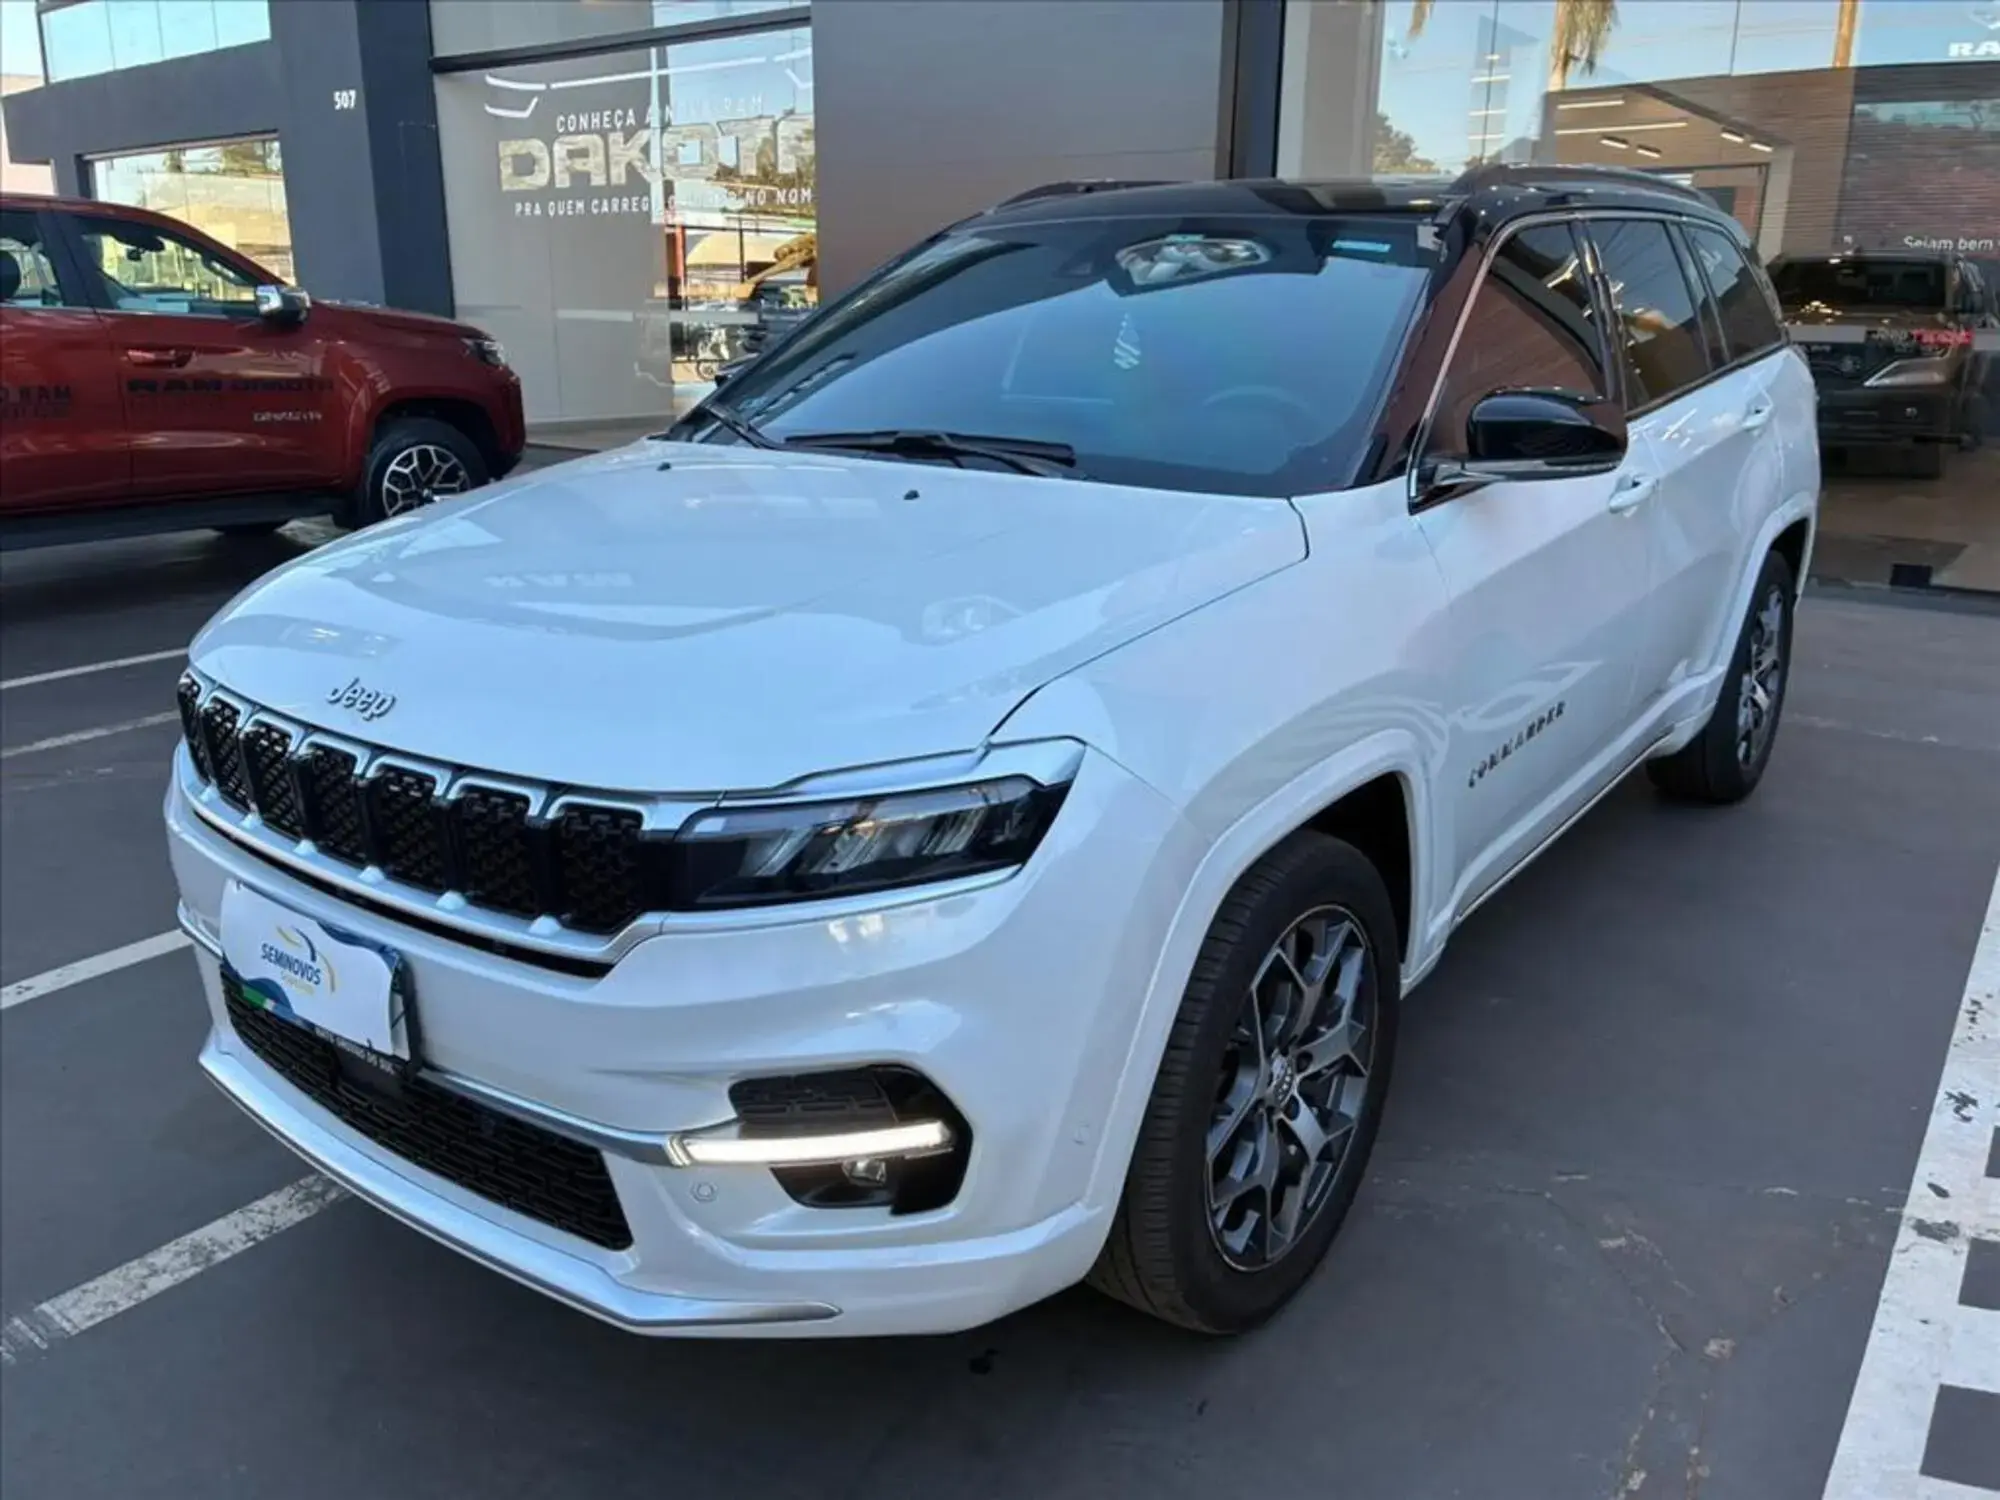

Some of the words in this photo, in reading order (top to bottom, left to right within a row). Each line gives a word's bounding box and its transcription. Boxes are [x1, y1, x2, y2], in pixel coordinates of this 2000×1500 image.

[1949, 41, 2000, 57] RA
[333, 89, 356, 110] 507
[556, 108, 636, 133] CONHEÇA
[499, 114, 815, 191] DAKOTA
[515, 202, 542, 216] PRA
[548, 200, 586, 218] QUEM
[591, 196, 652, 214] CARREG
[775, 187, 813, 205] NOM
[1468, 700, 1566, 789] COMMANDER
[261, 943, 321, 986] SEMINOVOS
